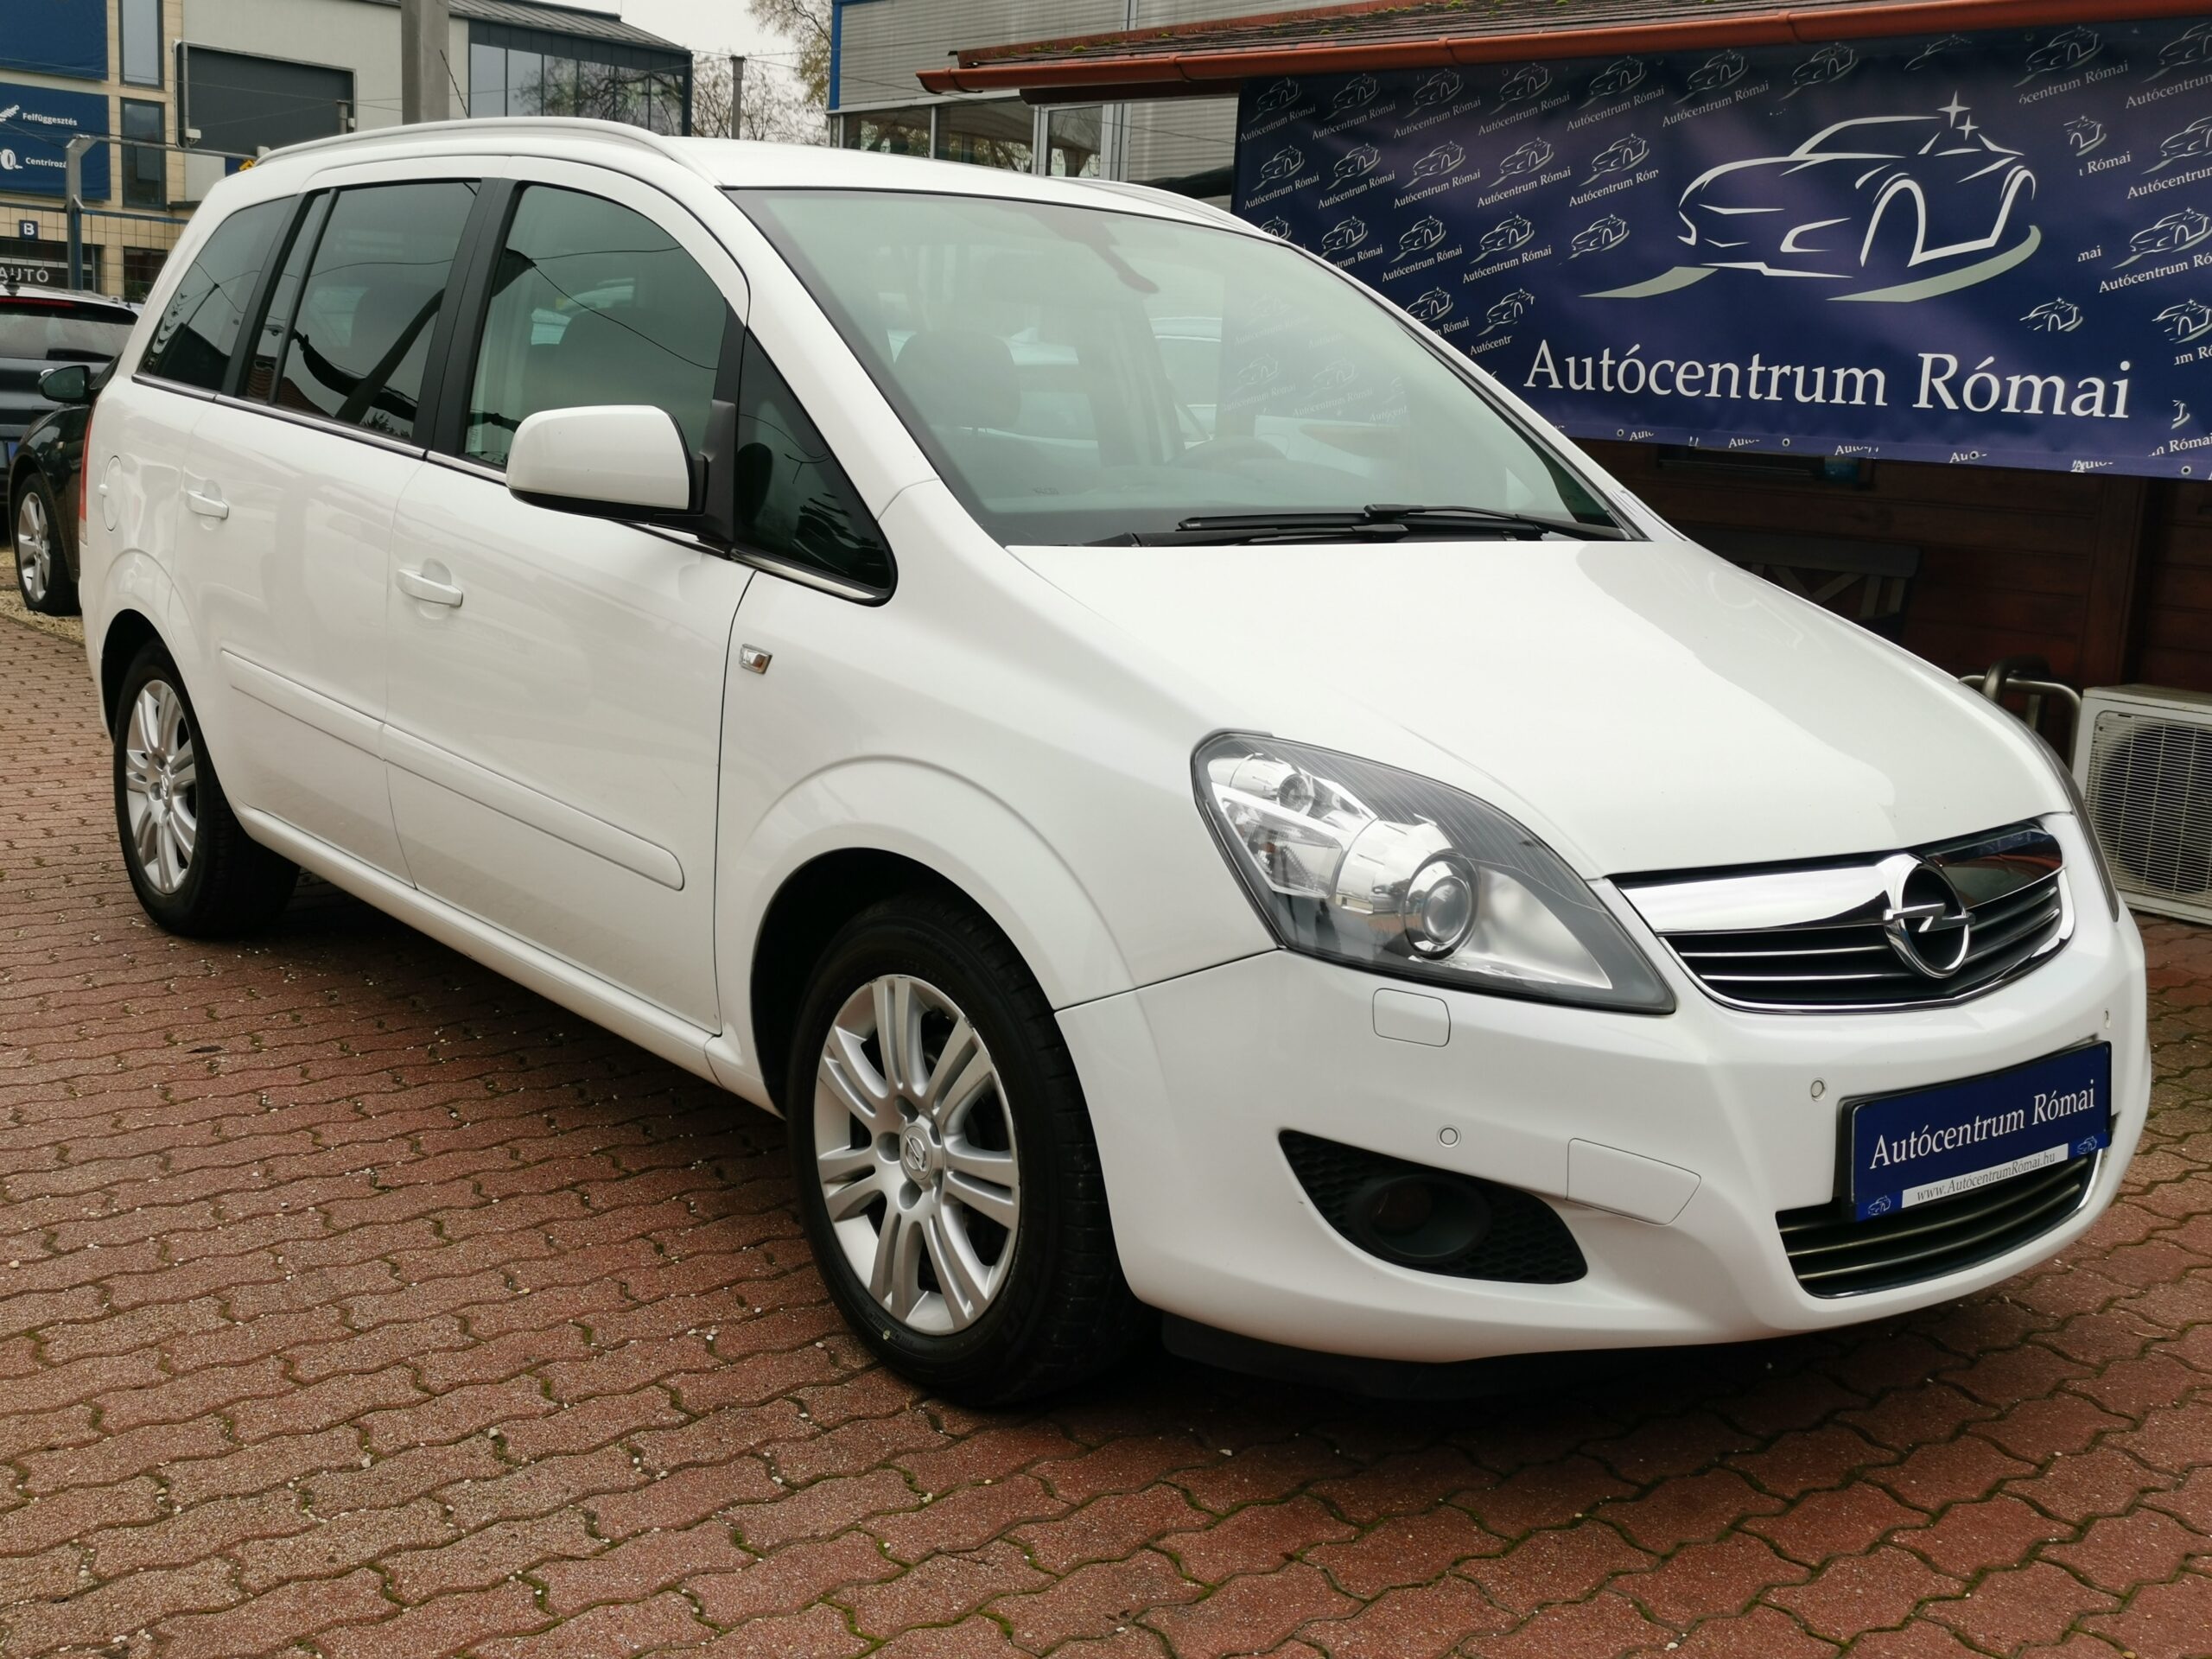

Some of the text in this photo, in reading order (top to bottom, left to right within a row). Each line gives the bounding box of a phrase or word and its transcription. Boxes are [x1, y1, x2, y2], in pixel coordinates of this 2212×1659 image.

[2085, 60, 2129, 84] Római
[22, 112, 78, 126] Felfüggesztés
[1289, 104, 1316, 121] Római
[1312, 100, 1396, 140] Autócentrum Római
[1394, 97, 1481, 138] Autócentrum Római
[1478, 92, 1570, 136] Autócentrum Római
[1567, 86, 1665, 131] Autócentrum Római
[1662, 80, 1770, 128] Autócentrum Római
[2088, 151, 2132, 174] Római
[1244, 173, 1319, 210] Autócentrum Római
[1318, 170, 1395, 209] Autócentrum Római
[1394, 169, 1481, 209] Autócentrum Római
[1478, 167, 1571, 207] Autócentrum Római
[1569, 179, 1633, 207] Autócentrum
[23, 223, 35, 236] B
[1357, 244, 1383, 262] Római
[1382, 245, 1463, 283] Autócentrum Római
[1463, 245, 1552, 284] Autócentrum Római
[2099, 262, 2189, 293] Autócentrum
[1443, 316, 1470, 335] Római
[1522, 339, 2131, 419] Autócentrum Római
[1870, 1079, 2094, 1169] Autócentrum Római
[1916, 1152, 2056, 1202] www.AutócentrumRómai.hu
